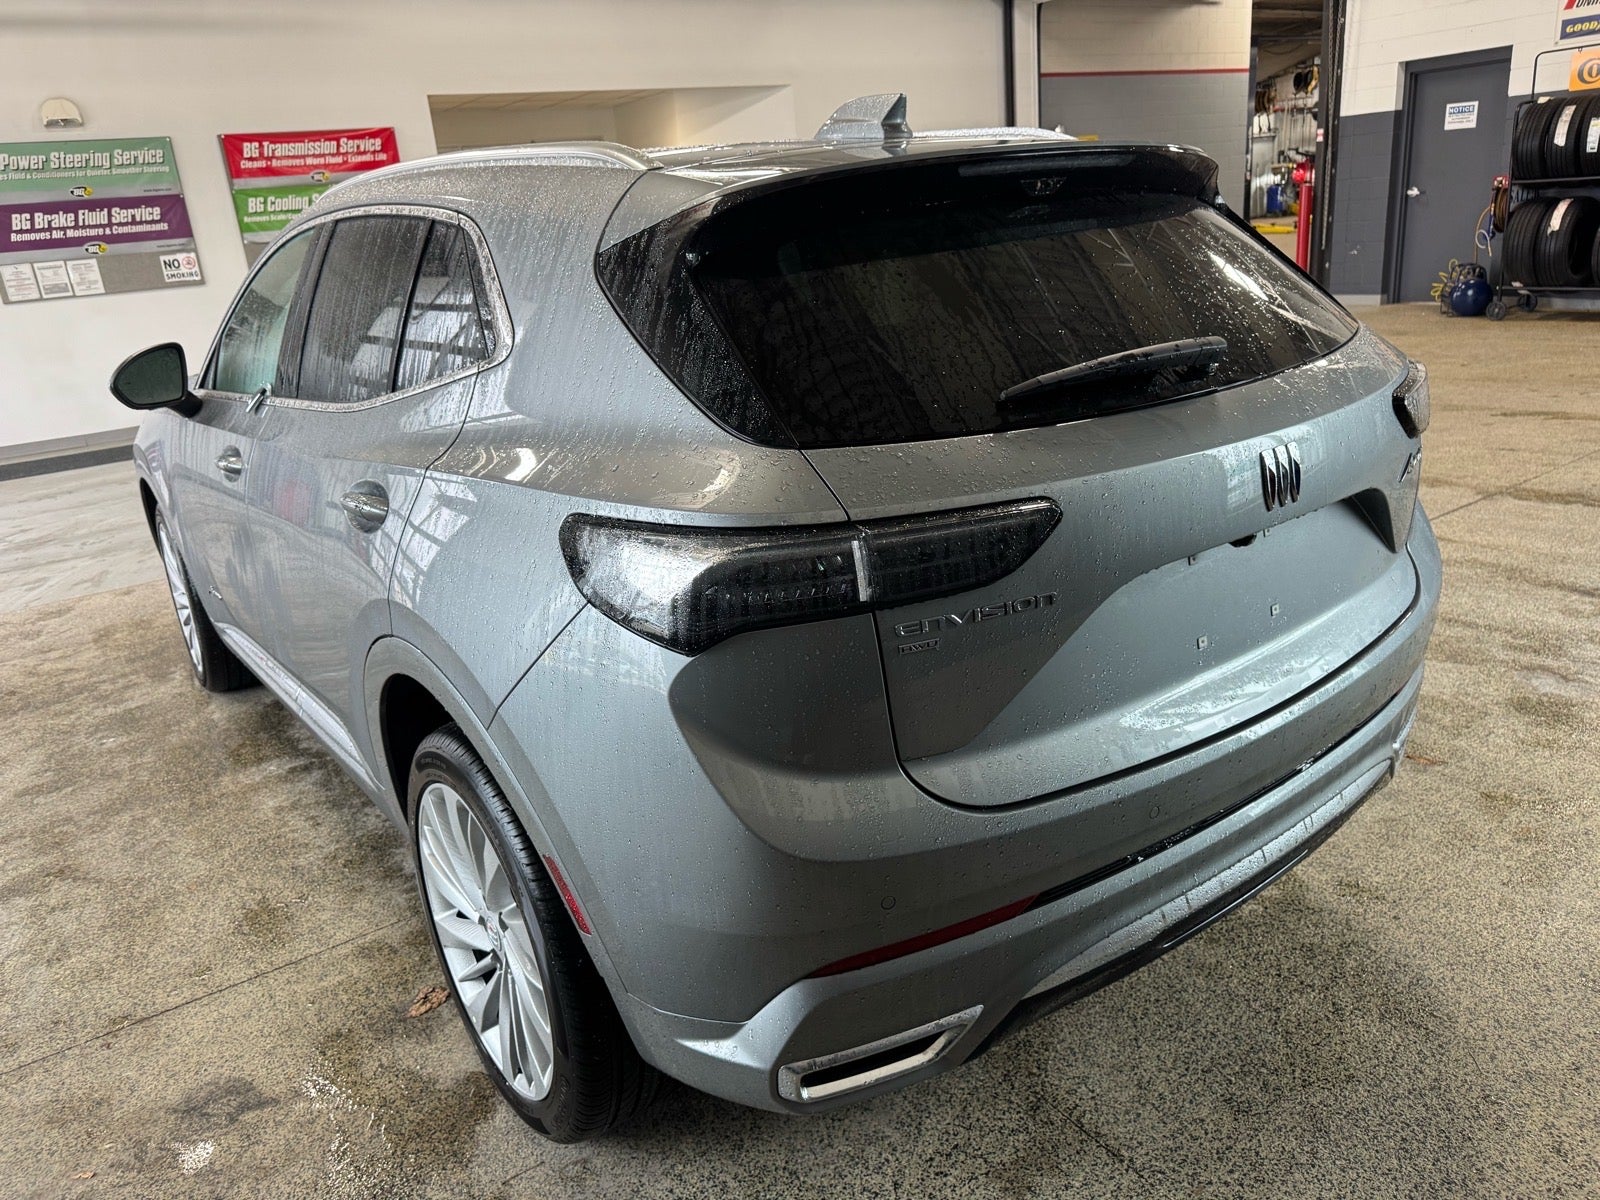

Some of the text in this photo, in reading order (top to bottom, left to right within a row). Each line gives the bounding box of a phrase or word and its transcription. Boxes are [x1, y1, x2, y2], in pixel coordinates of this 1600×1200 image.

[1449, 105, 1474, 114] NOTICE
[243, 136, 382, 158] BG Transmission Service
[0, 147, 164, 172] Power Steering Service
[240, 159, 267, 169] Cleans
[248, 196, 265, 213] BG
[267, 194, 310, 212] Cooling
[11, 205, 161, 231] BG Brake Fluid Service
[10, 231, 51, 242] Removes
[51, 230, 65, 239] Air,
[66, 227, 104, 238] Moisture
[112, 222, 169, 234] Contaminants
[163, 258, 180, 270] NO
[166, 270, 199, 280] SMOKING
[894, 591, 1058, 637] ENVISION
